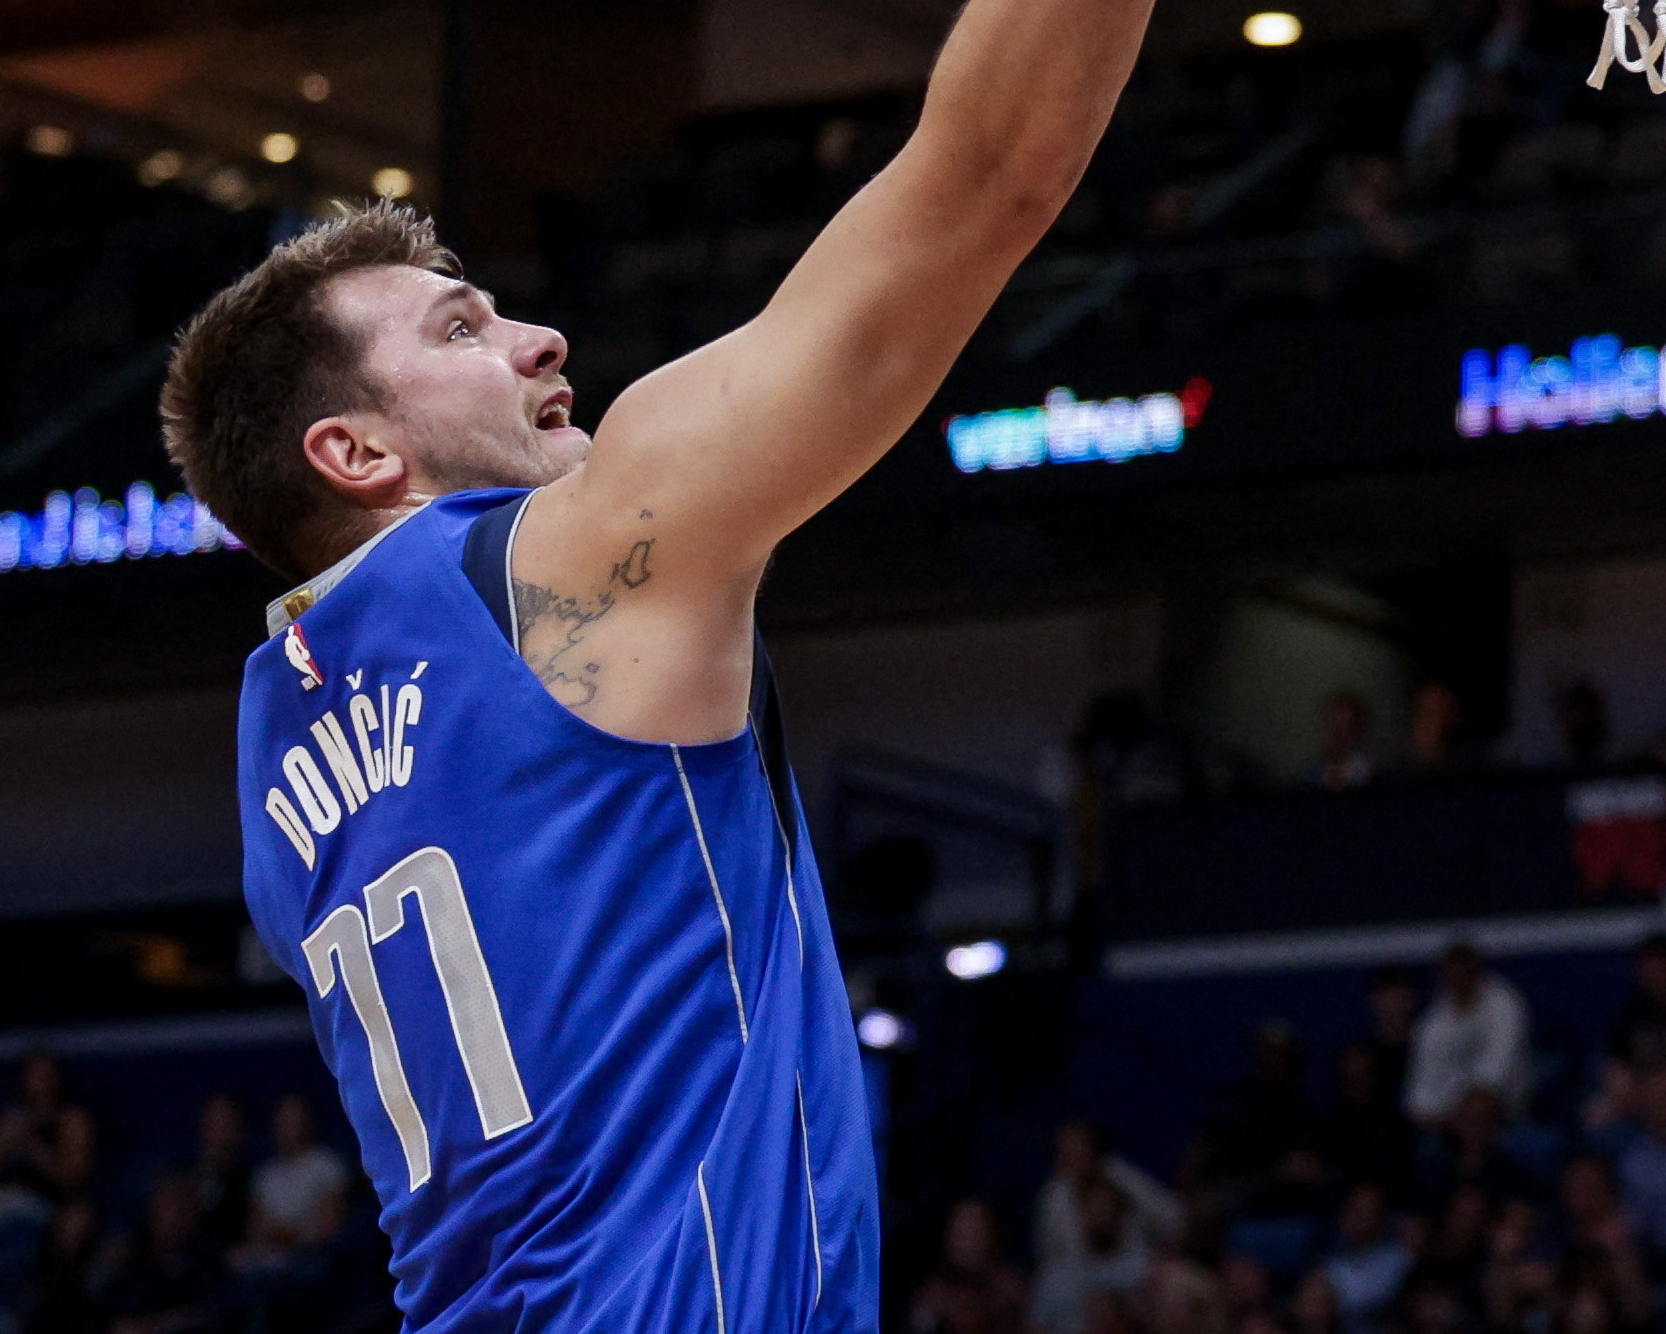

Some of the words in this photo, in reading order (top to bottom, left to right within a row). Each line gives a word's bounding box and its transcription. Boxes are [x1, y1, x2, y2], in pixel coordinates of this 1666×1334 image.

[946, 385, 1186, 474] verizon
[265, 661, 429, 872] DONČIĆ
[300, 846, 533, 1193] 77
